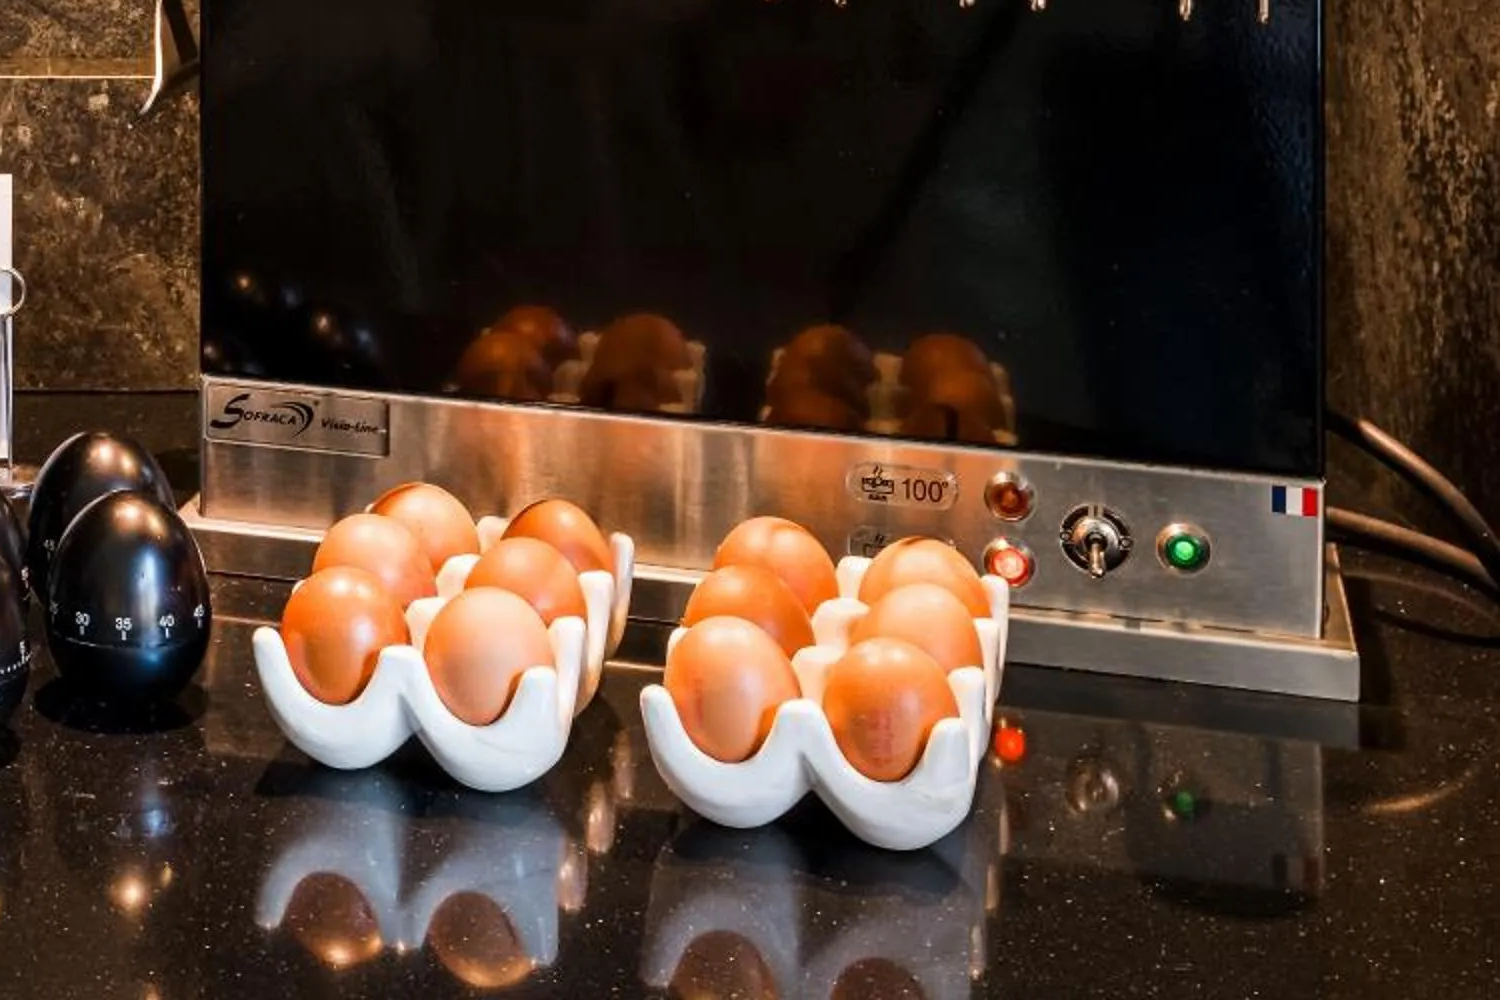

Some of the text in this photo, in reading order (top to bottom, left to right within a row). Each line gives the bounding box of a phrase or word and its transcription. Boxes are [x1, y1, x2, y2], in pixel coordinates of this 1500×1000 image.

[210, 393, 297, 429] SOFRACA
[75, 611, 91, 627] 30
[115, 617, 133, 631] 35
[159, 614, 175, 627] 40
